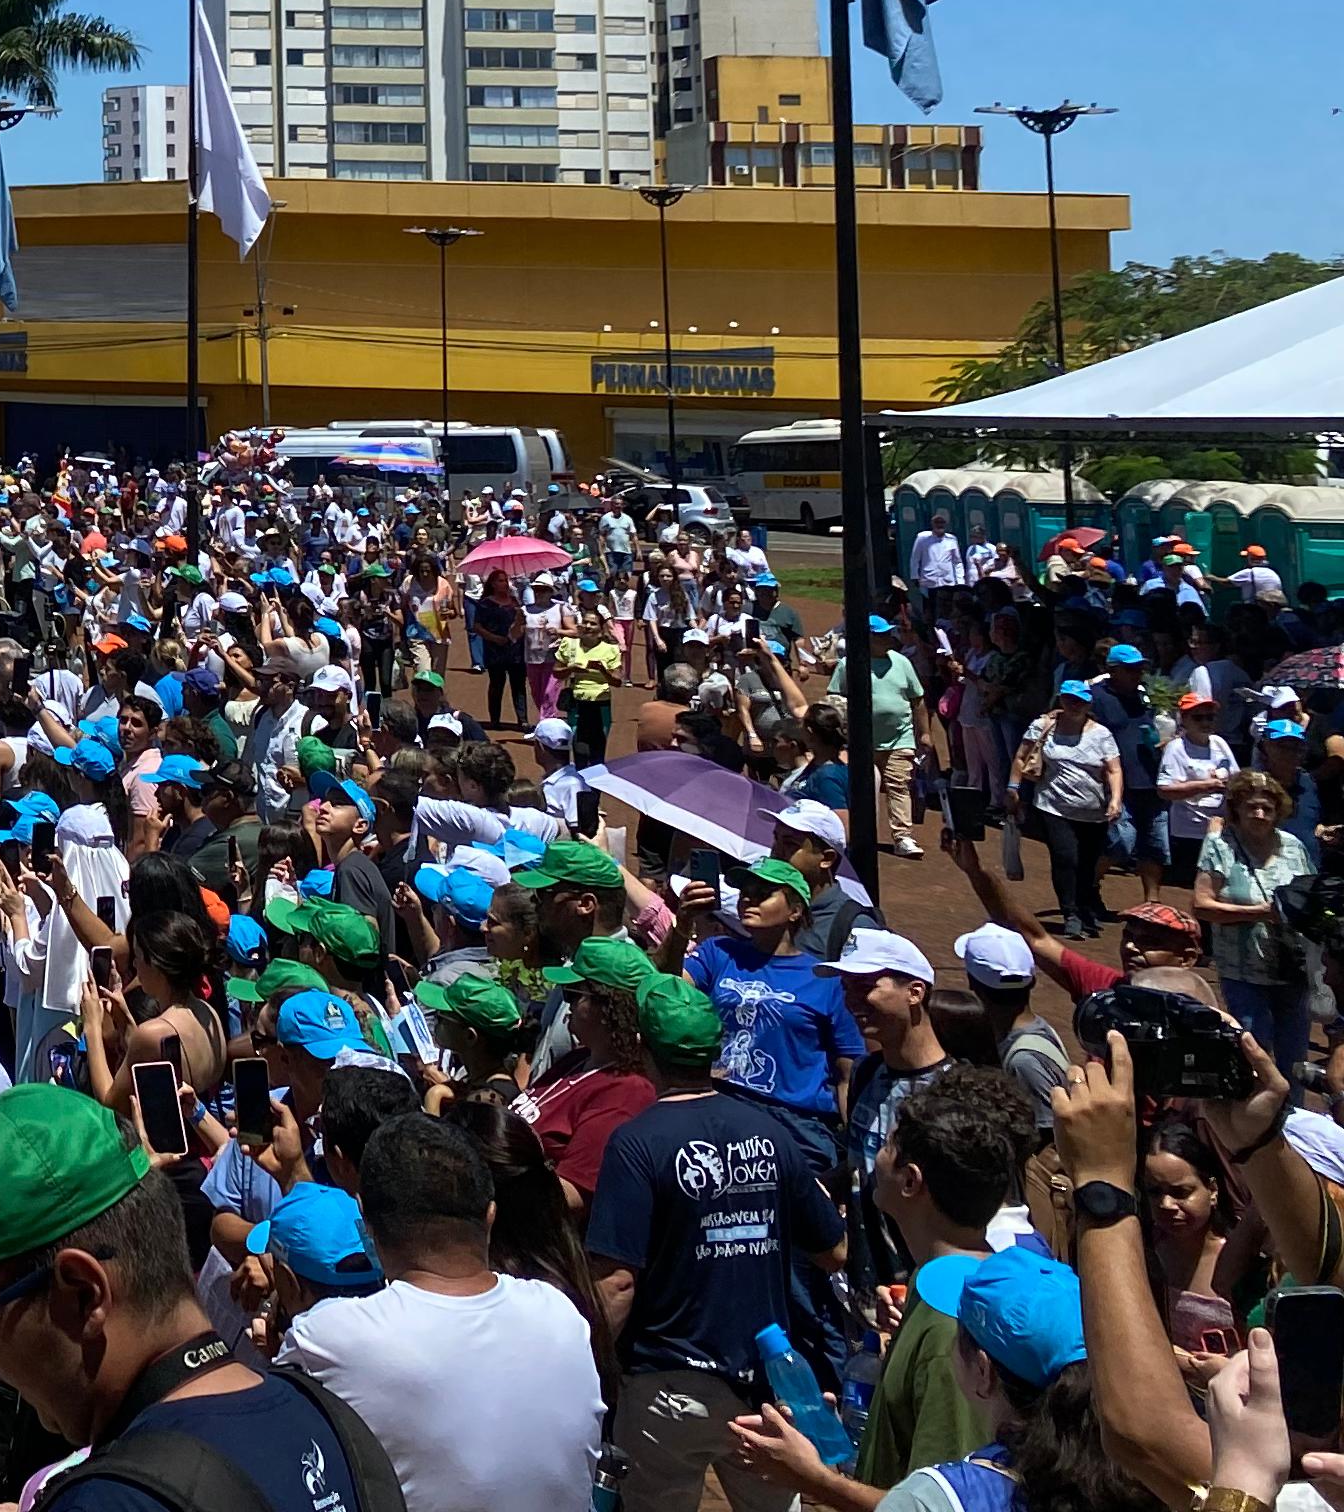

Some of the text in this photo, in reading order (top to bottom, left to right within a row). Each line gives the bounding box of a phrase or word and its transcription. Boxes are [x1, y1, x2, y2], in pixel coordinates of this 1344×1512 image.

[727, 1136, 775, 1161] MISSÃO
[726, 1159, 779, 1188] JOVEM
[183, 1341, 230, 1368] Canon
